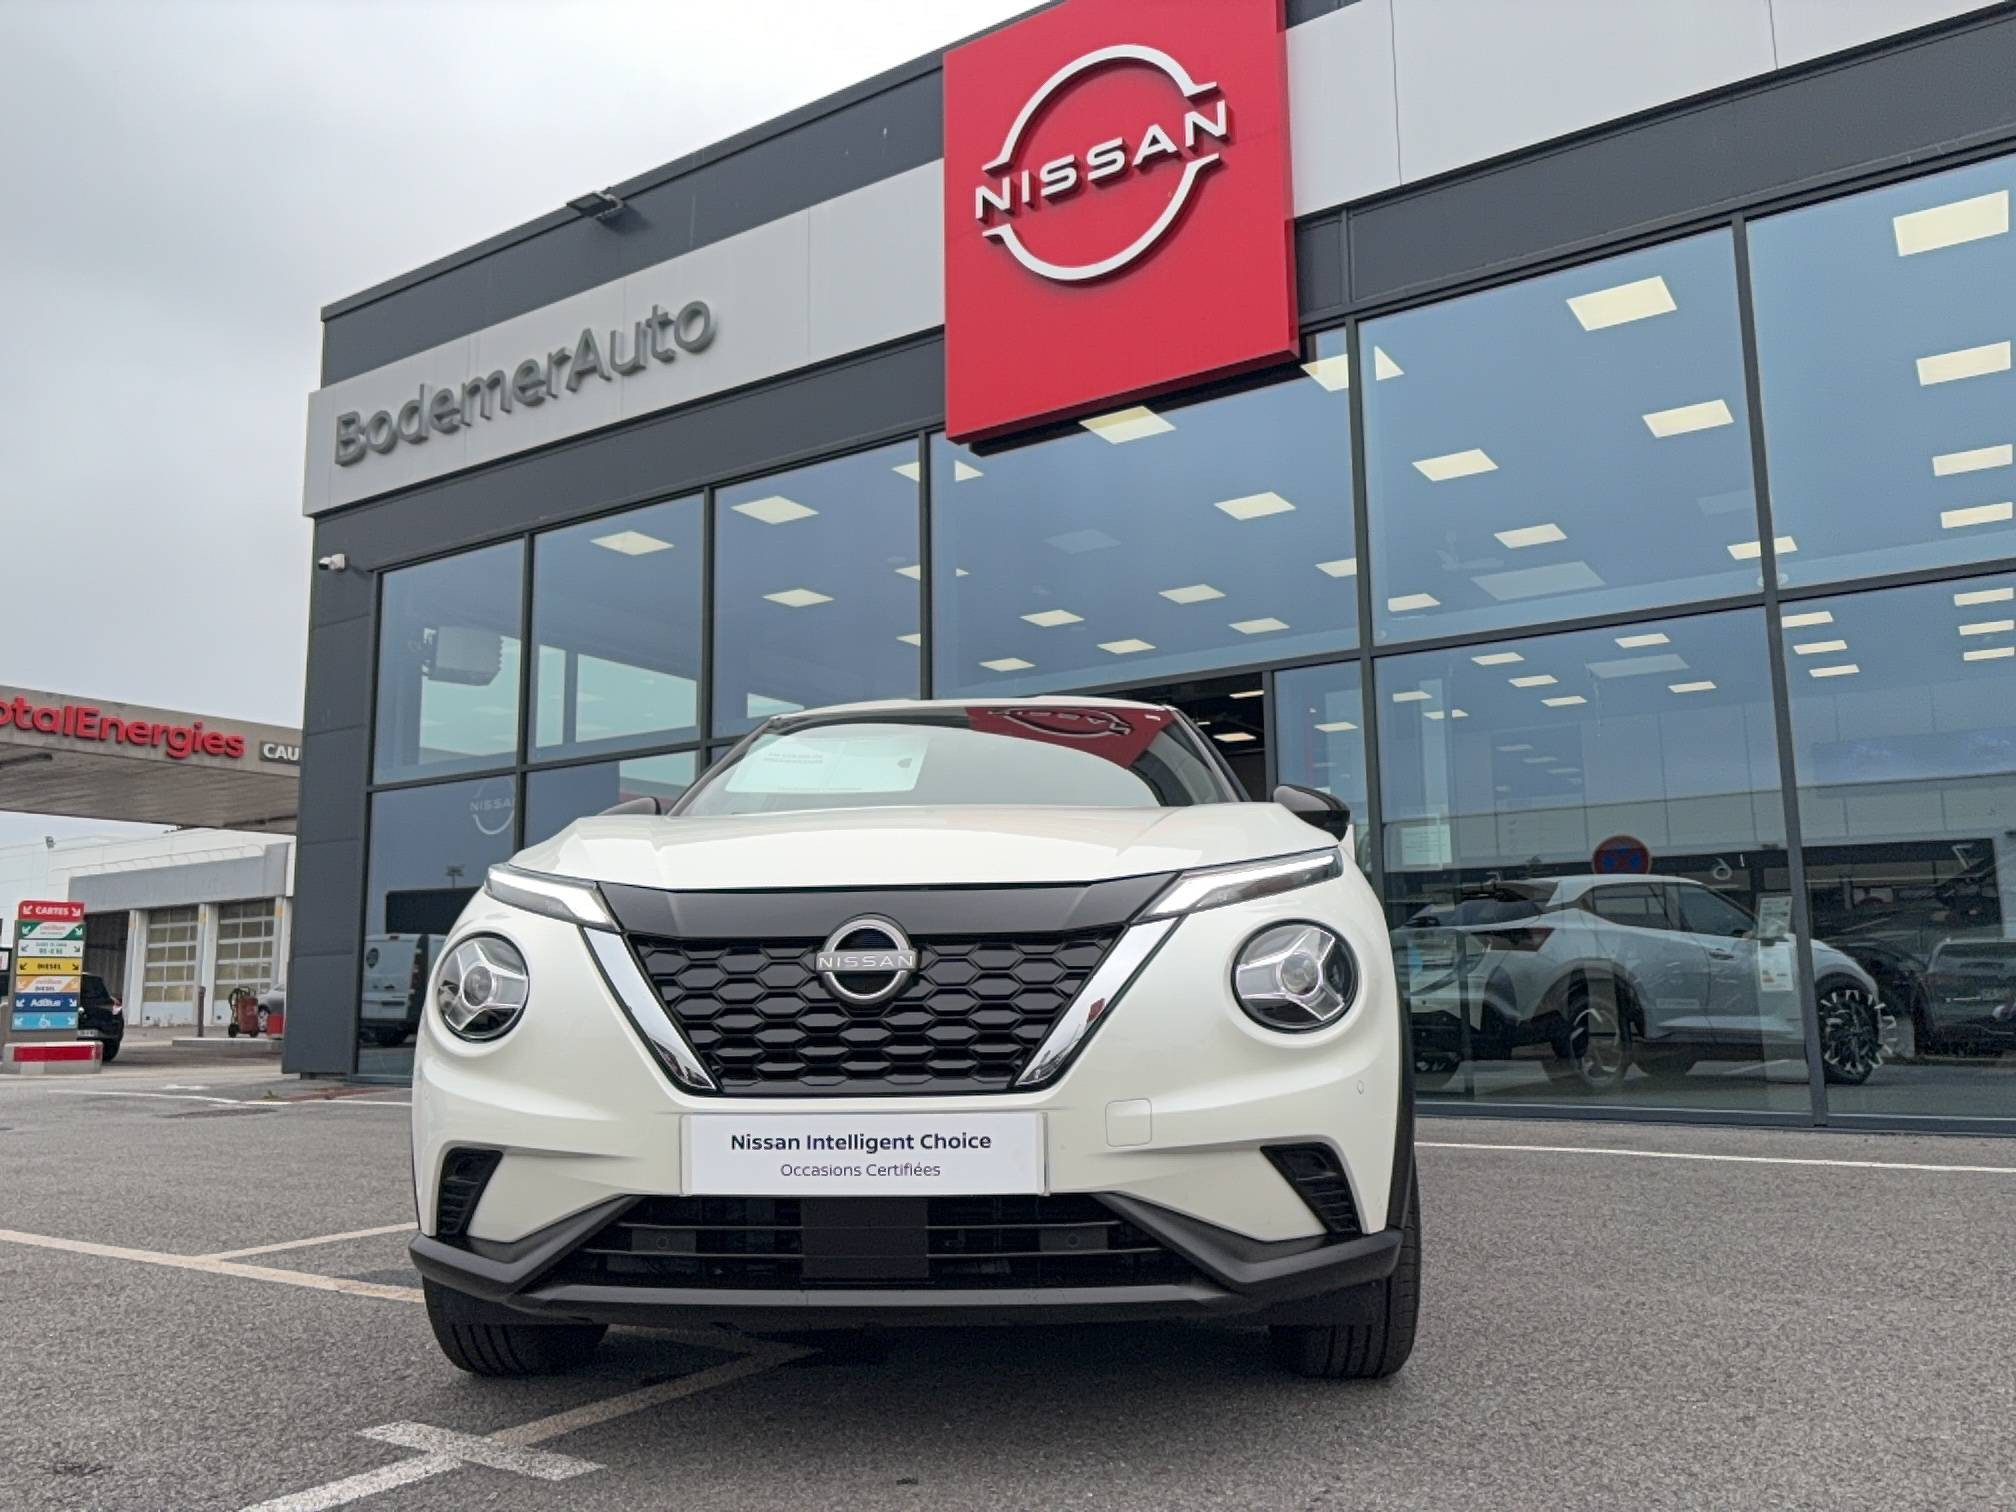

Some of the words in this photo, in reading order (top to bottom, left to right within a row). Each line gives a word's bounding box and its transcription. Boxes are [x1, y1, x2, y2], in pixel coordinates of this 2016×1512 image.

[974, 99, 1229, 222] NISSAN
[334, 299, 715, 467] BodemerAuto
[35, 906, 69, 916] CARTES
[818, 955, 913, 969] NISSAN
[30, 998, 62, 1007] AdBlue
[731, 1133, 801, 1151] Nissan
[806, 1132, 915, 1154] Intelligent
[920, 1131, 992, 1151] Choice
[780, 1163, 862, 1178] Occasions
[866, 1161, 941, 1177] Certifiées
